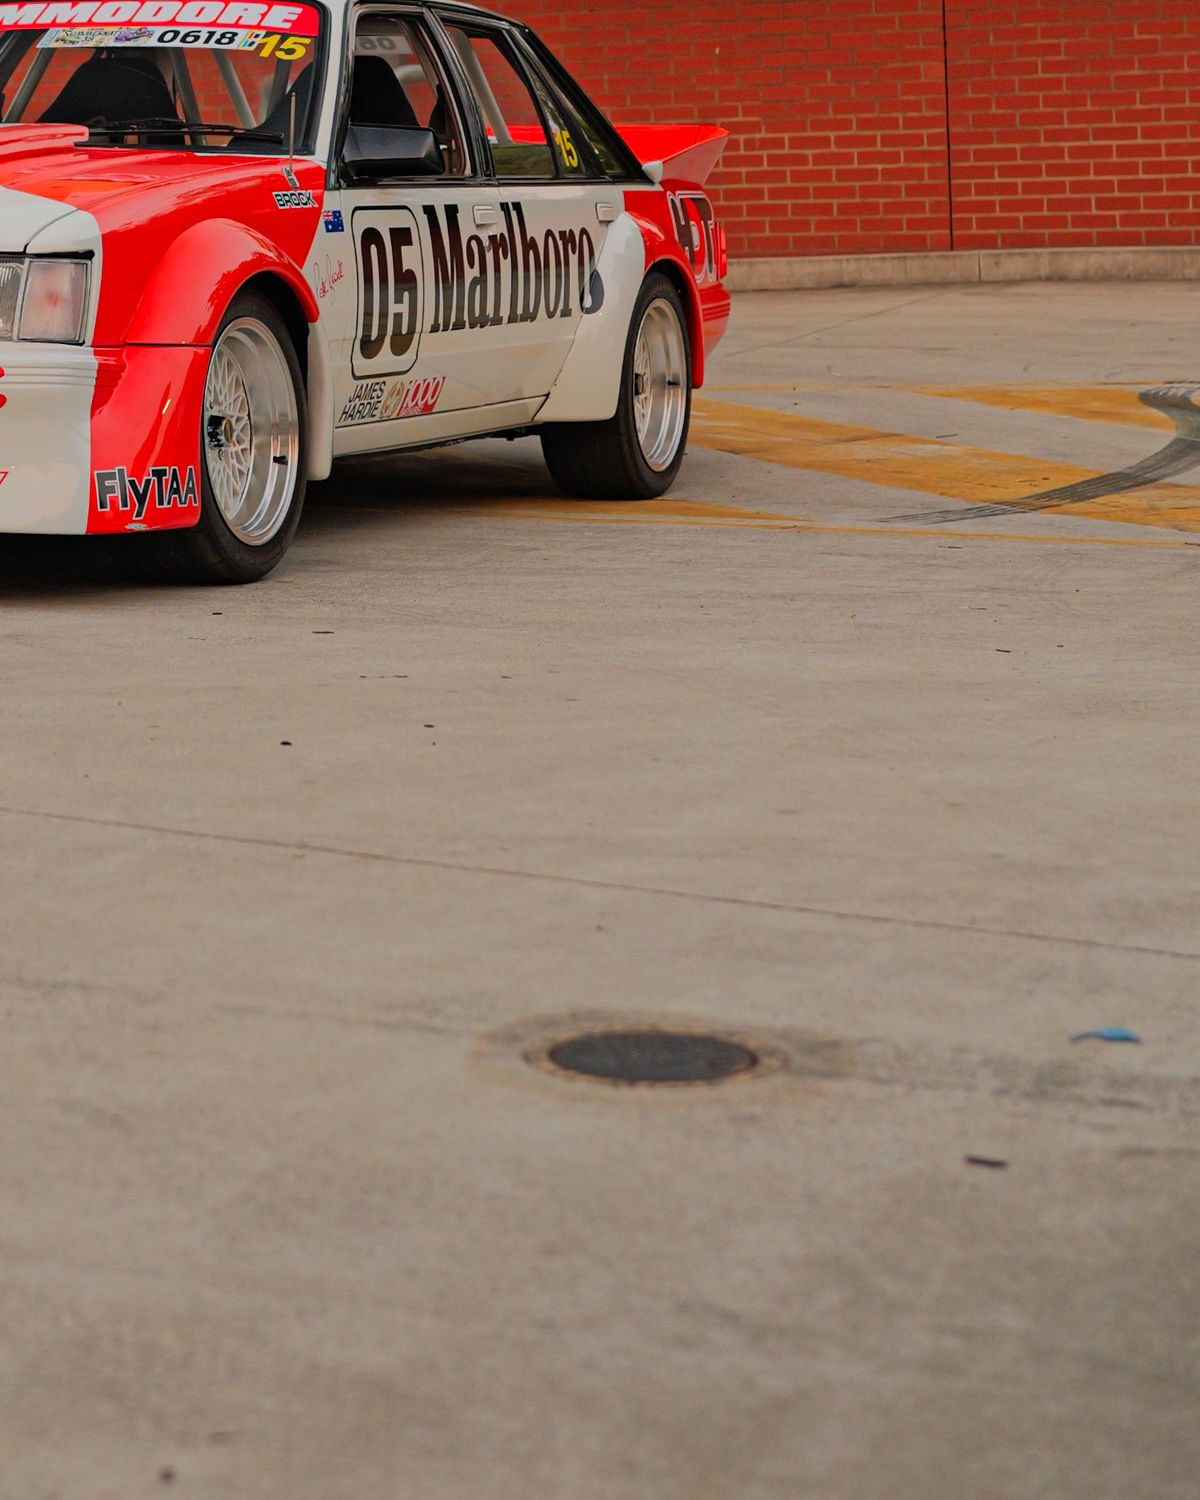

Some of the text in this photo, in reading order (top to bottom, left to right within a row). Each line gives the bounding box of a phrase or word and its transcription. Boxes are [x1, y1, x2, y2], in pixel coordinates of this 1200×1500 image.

[156, 29, 240, 46] 0618
[259, 34, 311, 61] 15
[555, 129, 579, 168] 15
[273, 191, 318, 208] BROCK
[422, 201, 605, 333] Marlboro
[360, 227, 418, 359] 05
[348, 381, 386, 403] JAMES
[338, 400, 381, 423] HARDIE
